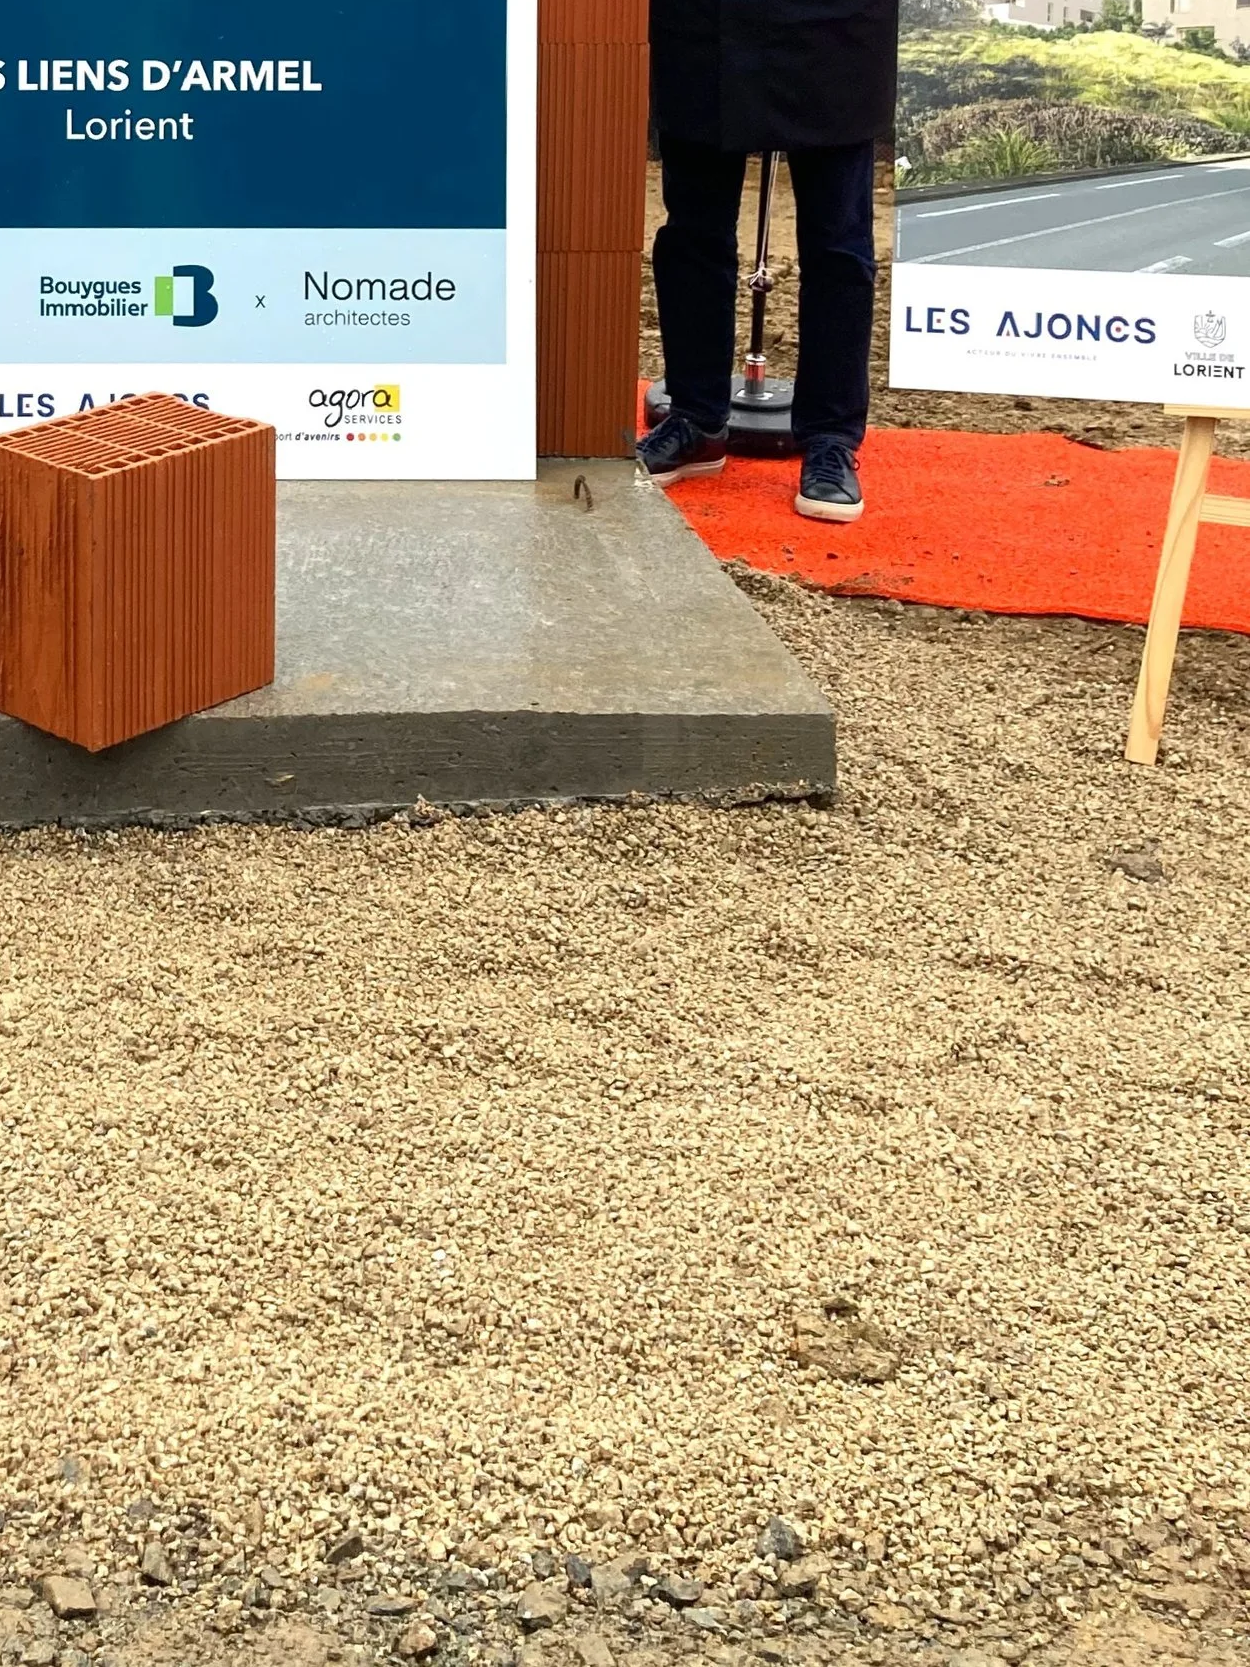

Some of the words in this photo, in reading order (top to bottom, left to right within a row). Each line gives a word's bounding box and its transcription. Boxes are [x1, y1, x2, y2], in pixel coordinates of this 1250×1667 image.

[18, 59, 129, 92] LIENS
[143, 60, 322, 91] D’ARMEL
[66, 109, 193, 140] Lorient
[40, 276, 141, 299] Bouygues
[304, 271, 456, 301] Nomade
[40, 298, 148, 317] Immobilier
[304, 310, 411, 326] architectes
[906, 306, 970, 334] LES
[996, 311, 1156, 344] AJONCS
[1174, 363, 1245, 379] LORIENT
[0, 393, 55, 417] LES
[309, 389, 392, 427] agora
[344, 415, 402, 424] SERVICES
[295, 432, 340, 441] d'avenirs
